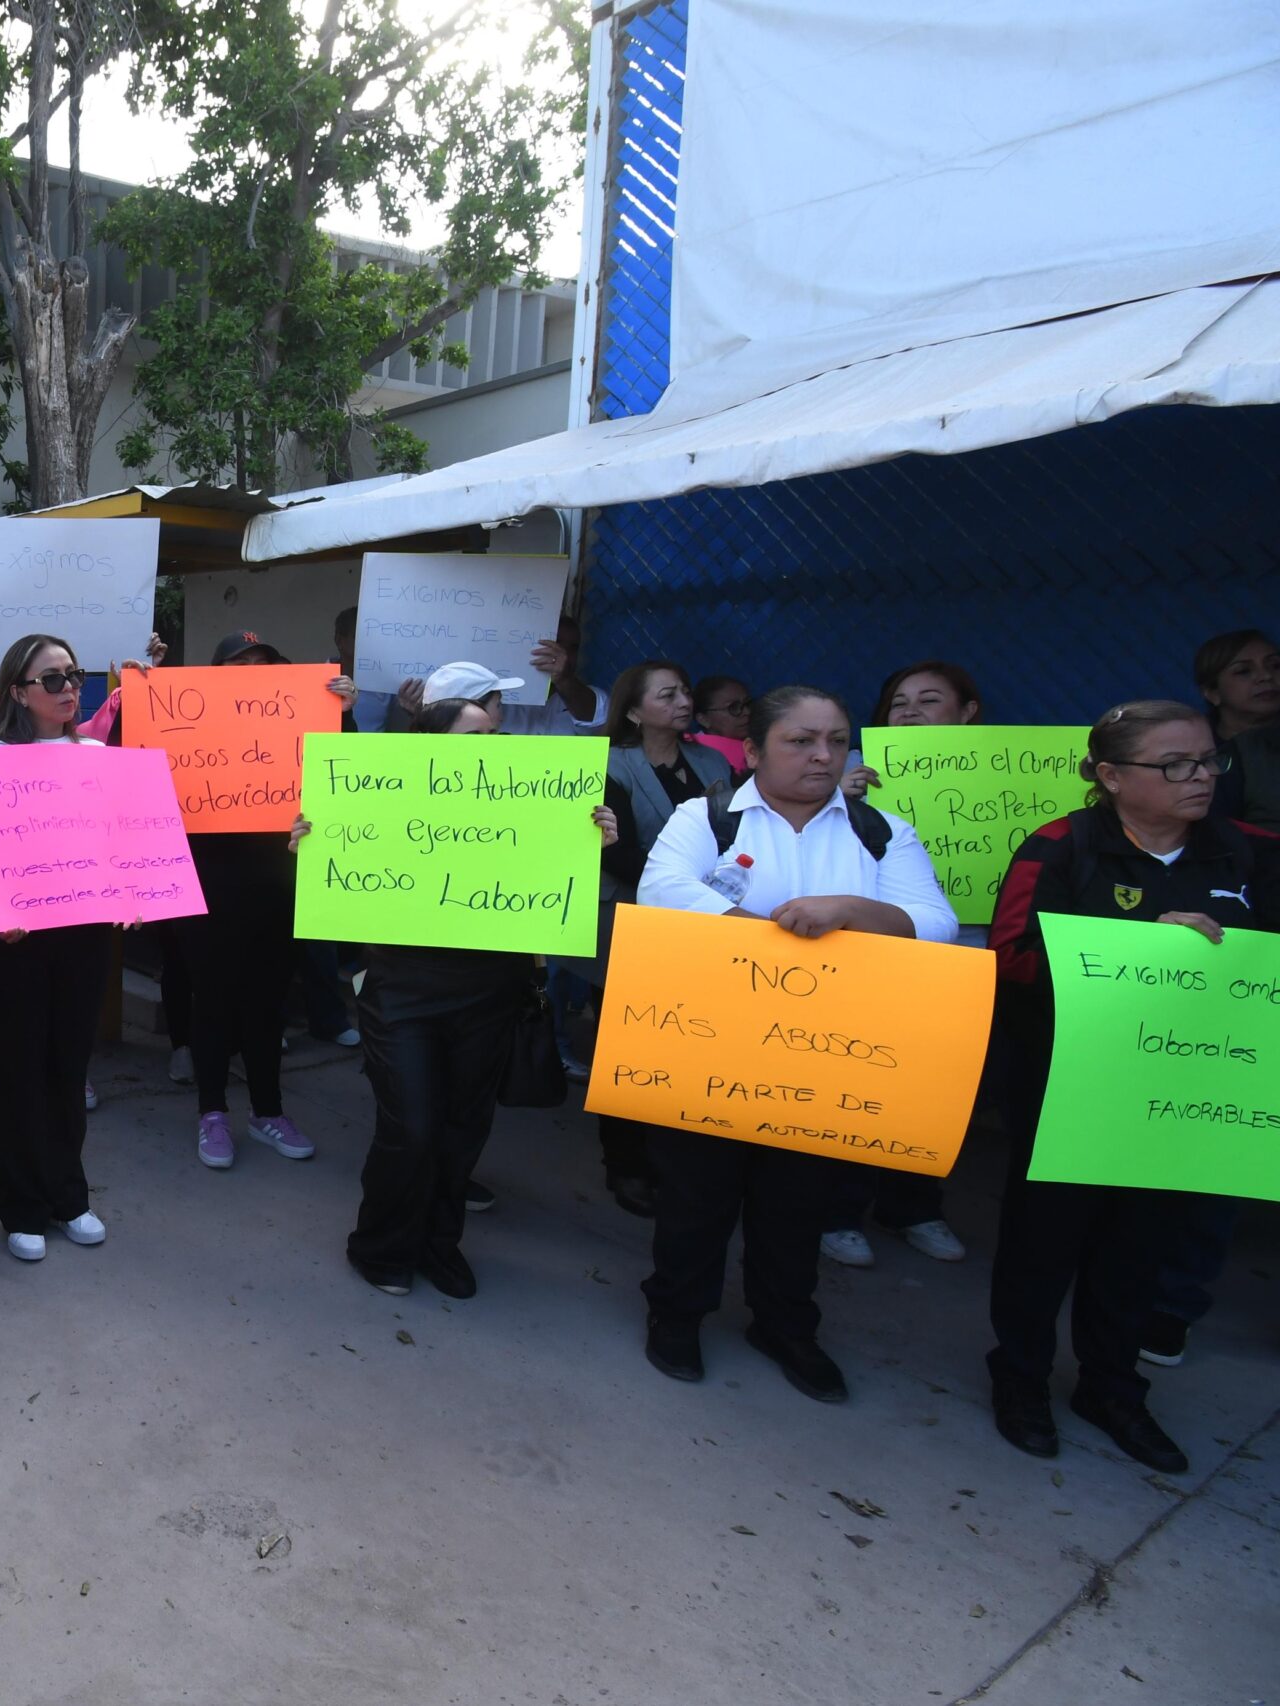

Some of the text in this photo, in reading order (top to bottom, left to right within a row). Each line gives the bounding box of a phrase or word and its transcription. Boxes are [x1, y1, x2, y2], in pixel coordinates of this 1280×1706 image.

[116, 596, 151, 617] 30
[376, 577, 545, 610] EXIGIMOS MÁS
[363, 617, 458, 638] PERSONAL
[471, 626, 498, 643] DE
[357, 658, 382, 672] EN
[148, 683, 297, 722] NO más
[140, 744, 229, 772] usos
[241, 739, 275, 765] de
[884, 744, 979, 780] Exigimos
[991, 748, 1011, 775] el
[177, 780, 302, 814] utoridad
[323, 757, 605, 802] Fuera las Autoridades
[324, 818, 517, 855] que ejercen
[922, 834, 993, 858] estras
[0, 858, 99, 879] nuestras
[10, 888, 97, 910] Generales
[100, 884, 122, 899] de
[324, 857, 574, 926] Acoso Laboral
[1079, 951, 1208, 991] EXIGIMOS
[623, 1002, 898, 1069] MÁS ABUSOS
[1137, 1020, 1258, 1064] laborales
[613, 1064, 885, 1116] POR PARTE DE
[1147, 1098, 1280, 1129] FAVORABLES
[679, 1110, 940, 1162] LAS AUTORIDADES
